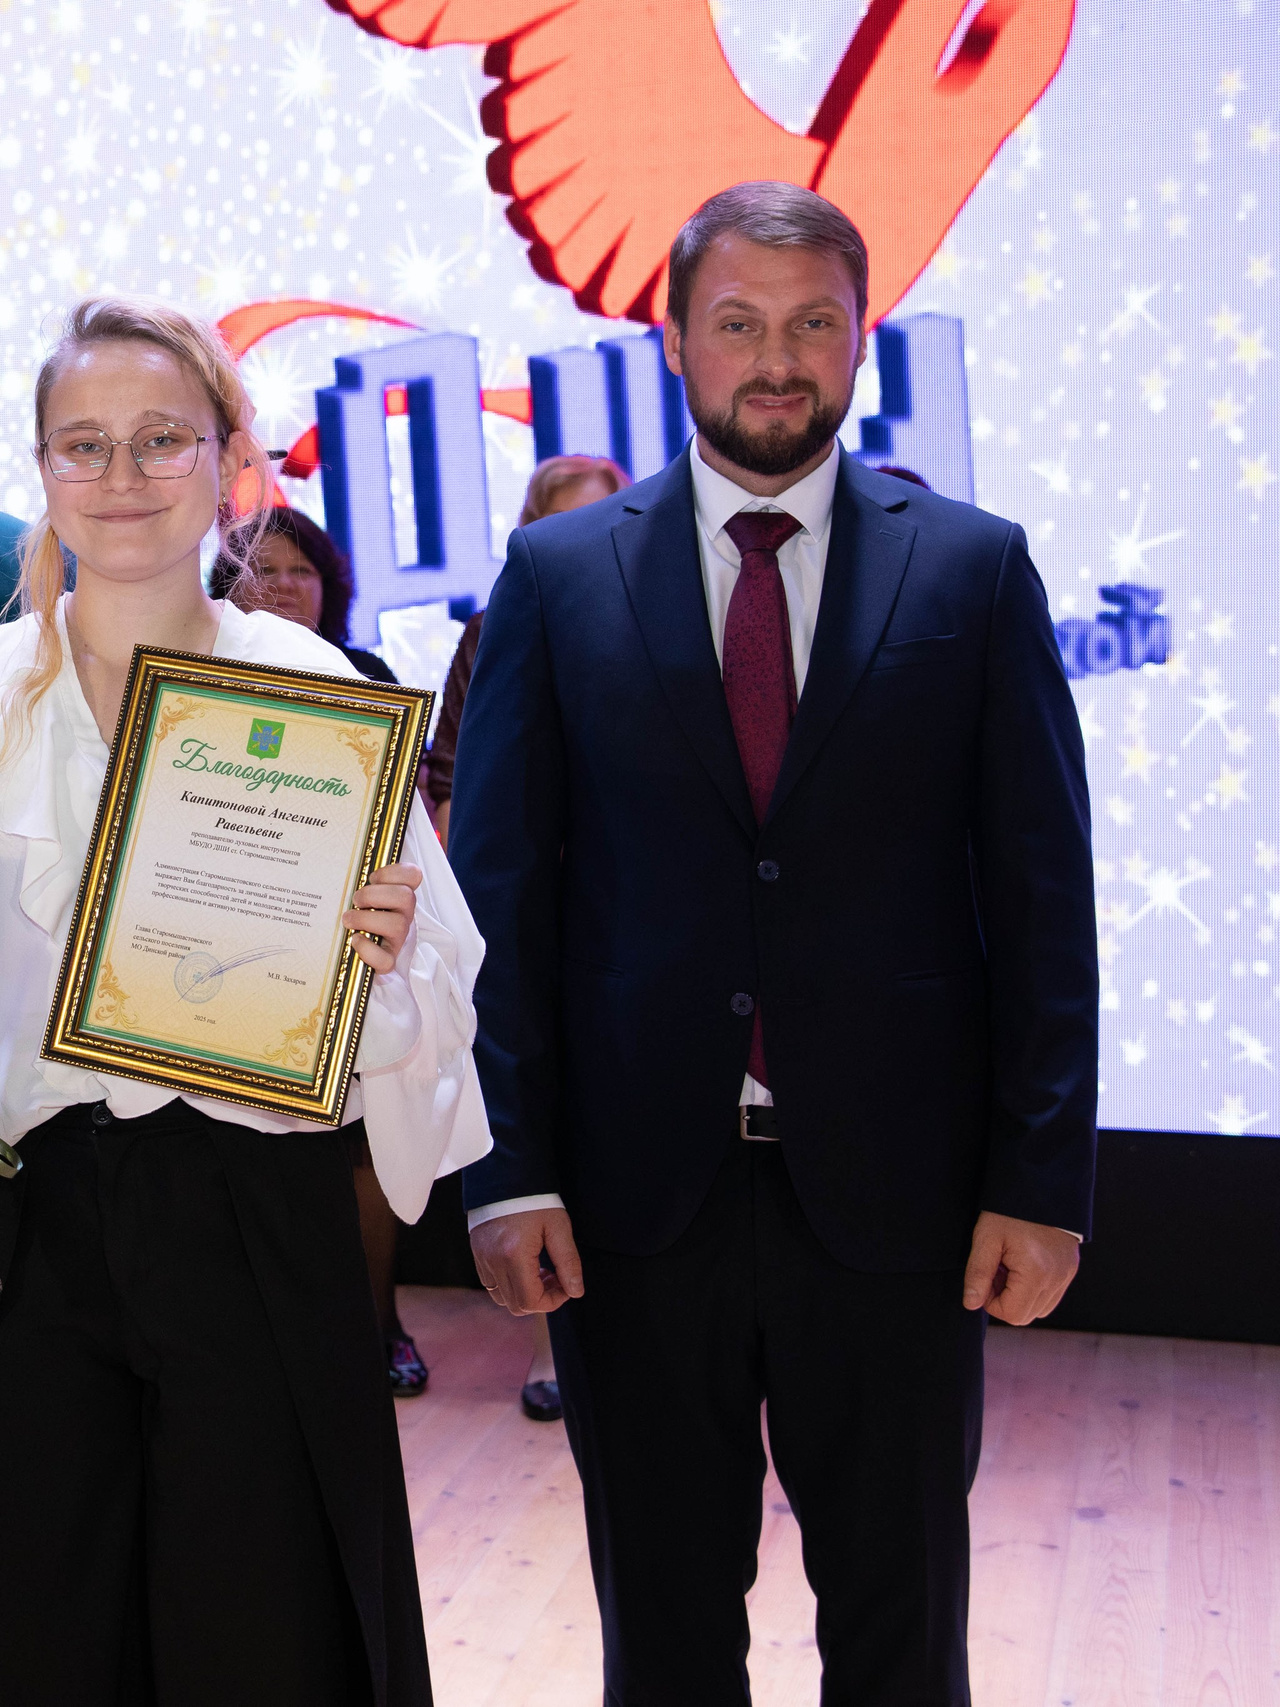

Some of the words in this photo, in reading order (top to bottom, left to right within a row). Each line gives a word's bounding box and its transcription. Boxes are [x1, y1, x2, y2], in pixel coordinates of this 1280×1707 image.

[172, 738, 352, 797] Благодарность
[180, 790, 266, 817] Капитоновой
[268, 807, 328, 828] Ангелине
[214, 817, 283, 840] Равельевне
[189, 839, 212, 849] МБУДО
[213, 843, 230, 853] ДШИ
[239, 849, 299, 866] Старомышастовской
[191, 831, 234, 844] преподавателю
[234, 840, 259, 849] духовых
[260, 844, 300, 857] инструментов
[154, 861, 199, 876] Администрация
[200, 870, 261, 888] Старомышастовского
[262, 883, 291, 894] сельского
[292, 889, 322, 900] поселения
[154, 871, 182, 881] выражает
[183, 876, 195, 884] Вам
[196, 879, 237, 893] благодарность
[245, 889, 268, 899] личный
[268, 894, 285, 903] вклад
[291, 899, 318, 909] развитие
[151, 889, 202, 905] профессионализм
[208, 902, 236, 912] активную
[237, 908, 271, 919] творческую
[271, 914, 312, 927] деятельность.
[157, 881, 189, 893] творческих
[190, 888, 230, 900] способностей
[231, 896, 247, 904] детей
[285, 908, 310, 917] высокий
[133, 934, 161, 945] сельского
[161, 940, 191, 951] поселения
[135, 924, 151, 933] Глава
[152, 927, 213, 946] Старомышастовского
[143, 945, 167, 955] Динской
[168, 951, 186, 960] район
[283, 974, 307, 986] Захаров
[194, 1014, 206, 1022] 2025
